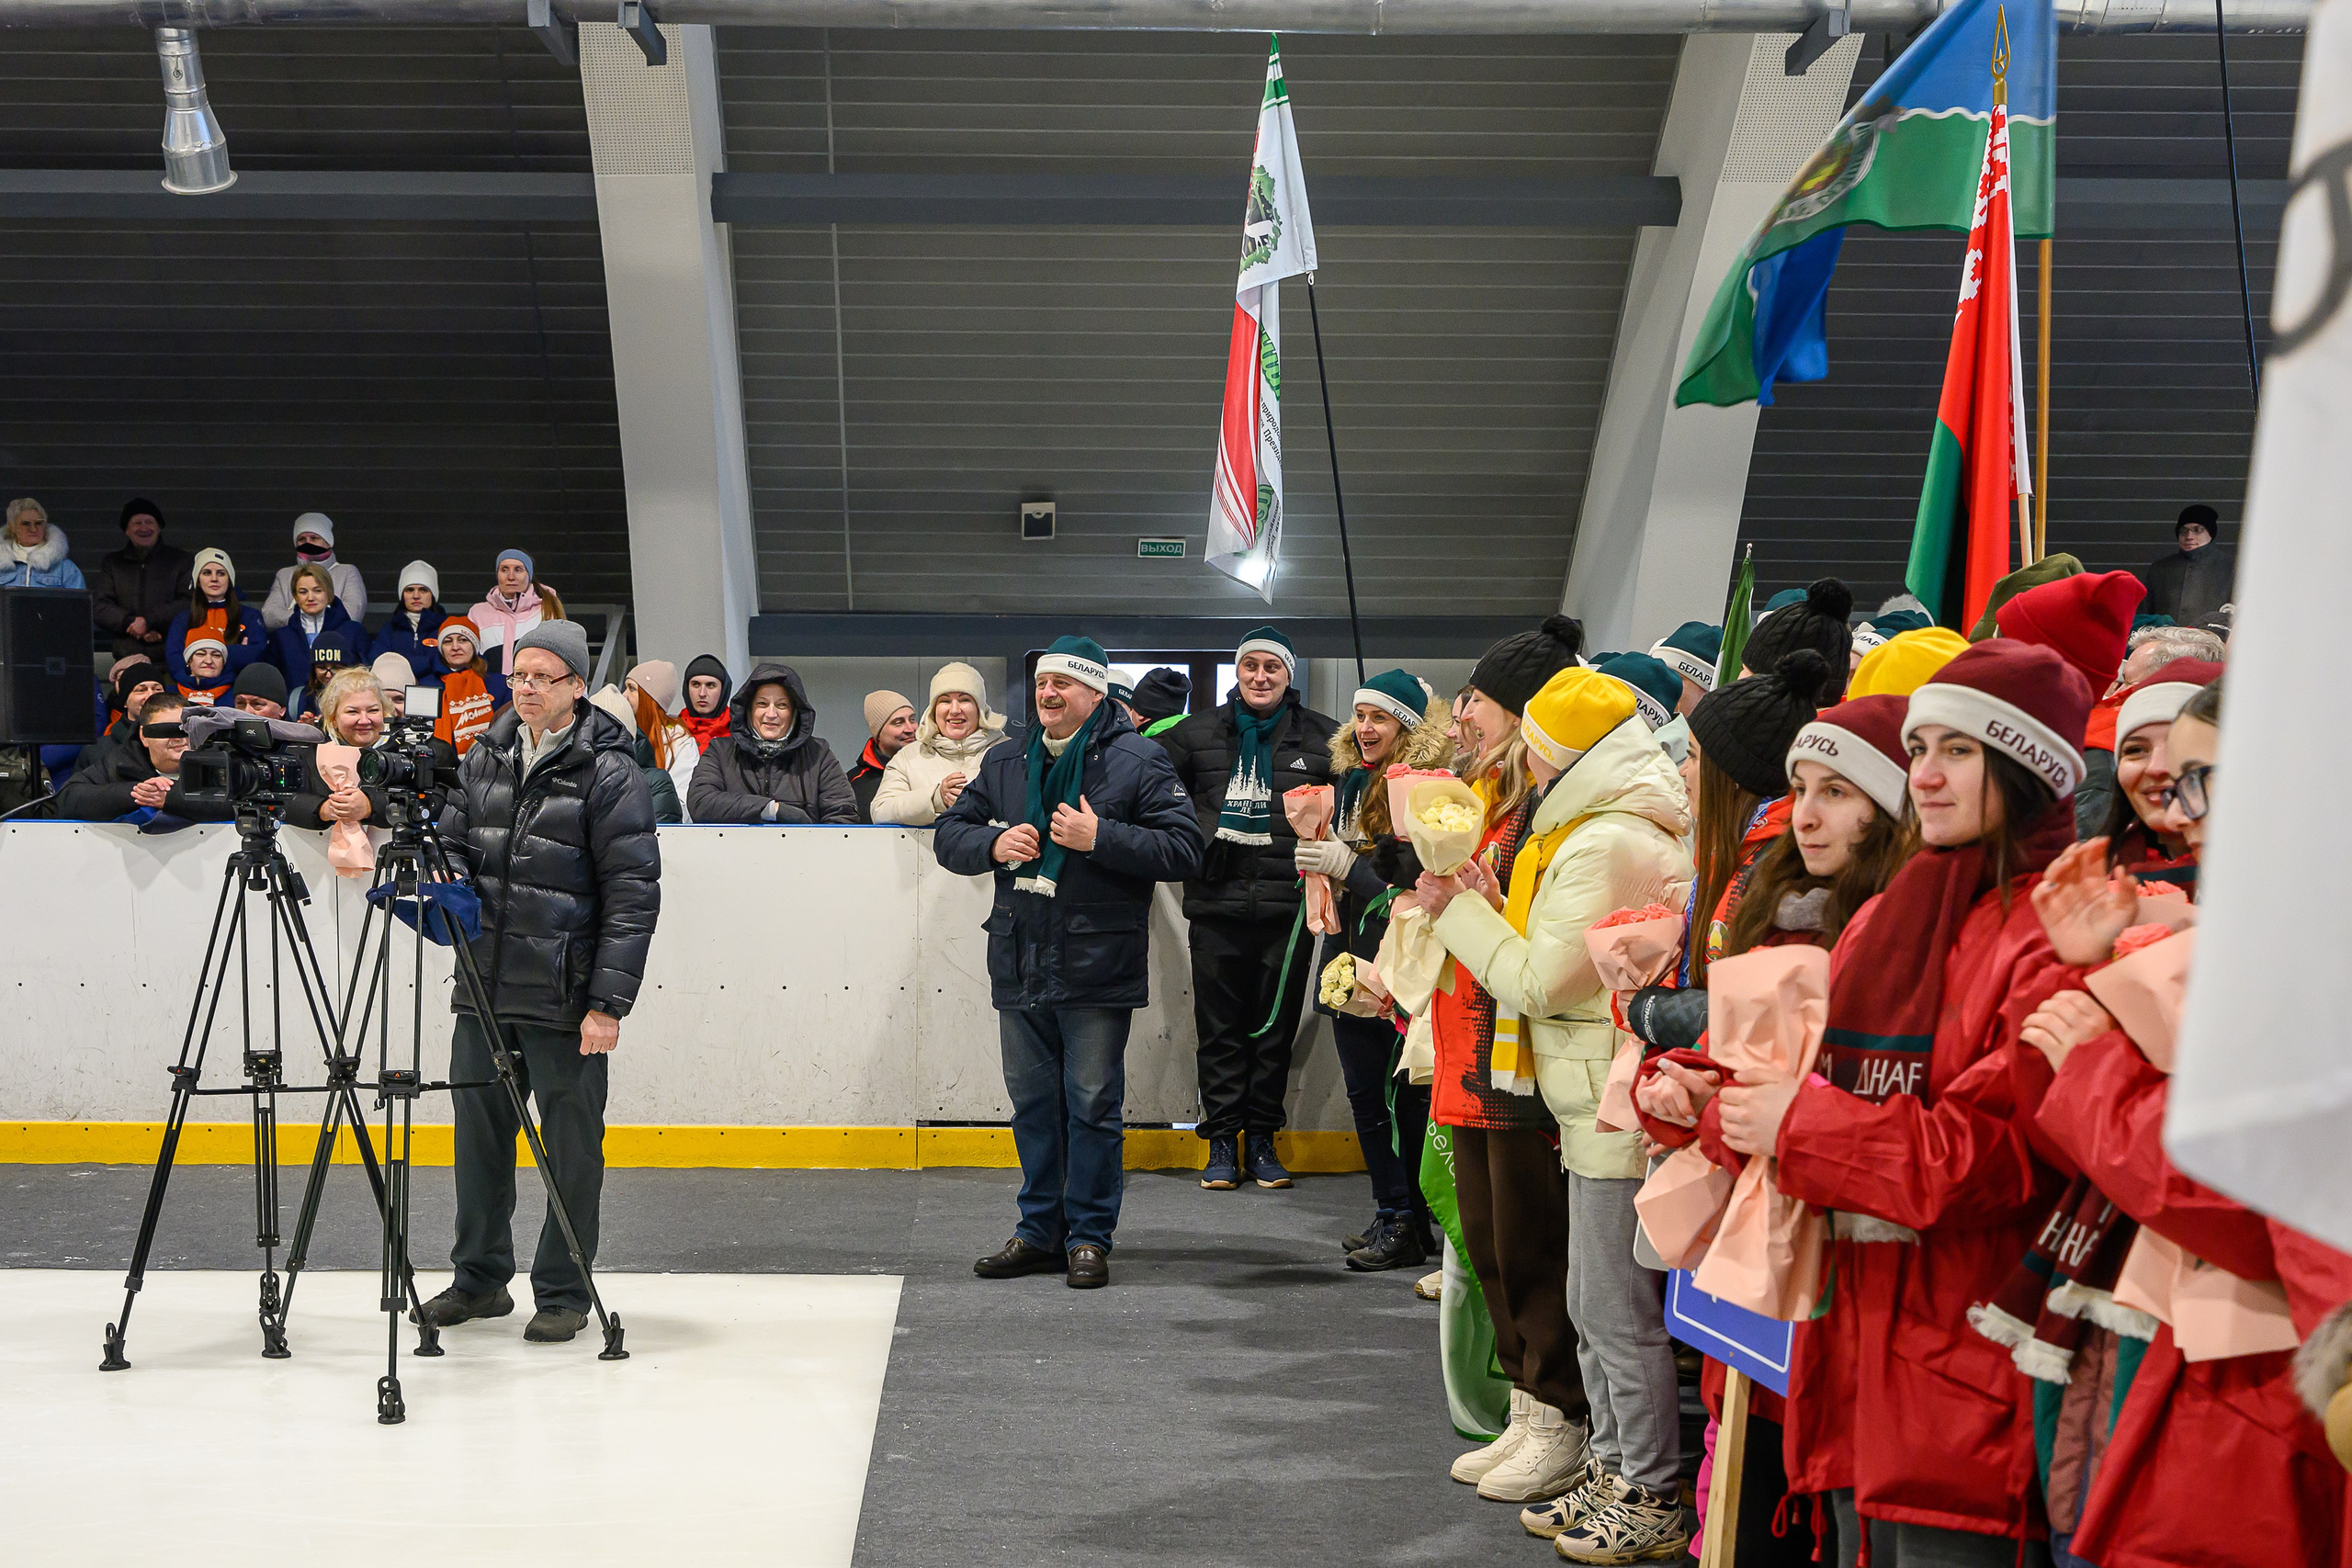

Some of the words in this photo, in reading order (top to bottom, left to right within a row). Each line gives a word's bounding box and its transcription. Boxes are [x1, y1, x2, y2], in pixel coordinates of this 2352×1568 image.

[1141, 544, 1182, 555] ВЫХОД
[314, 649, 341, 661] ICON
[1634, 695, 1664, 727] ЛАРУСЬ
